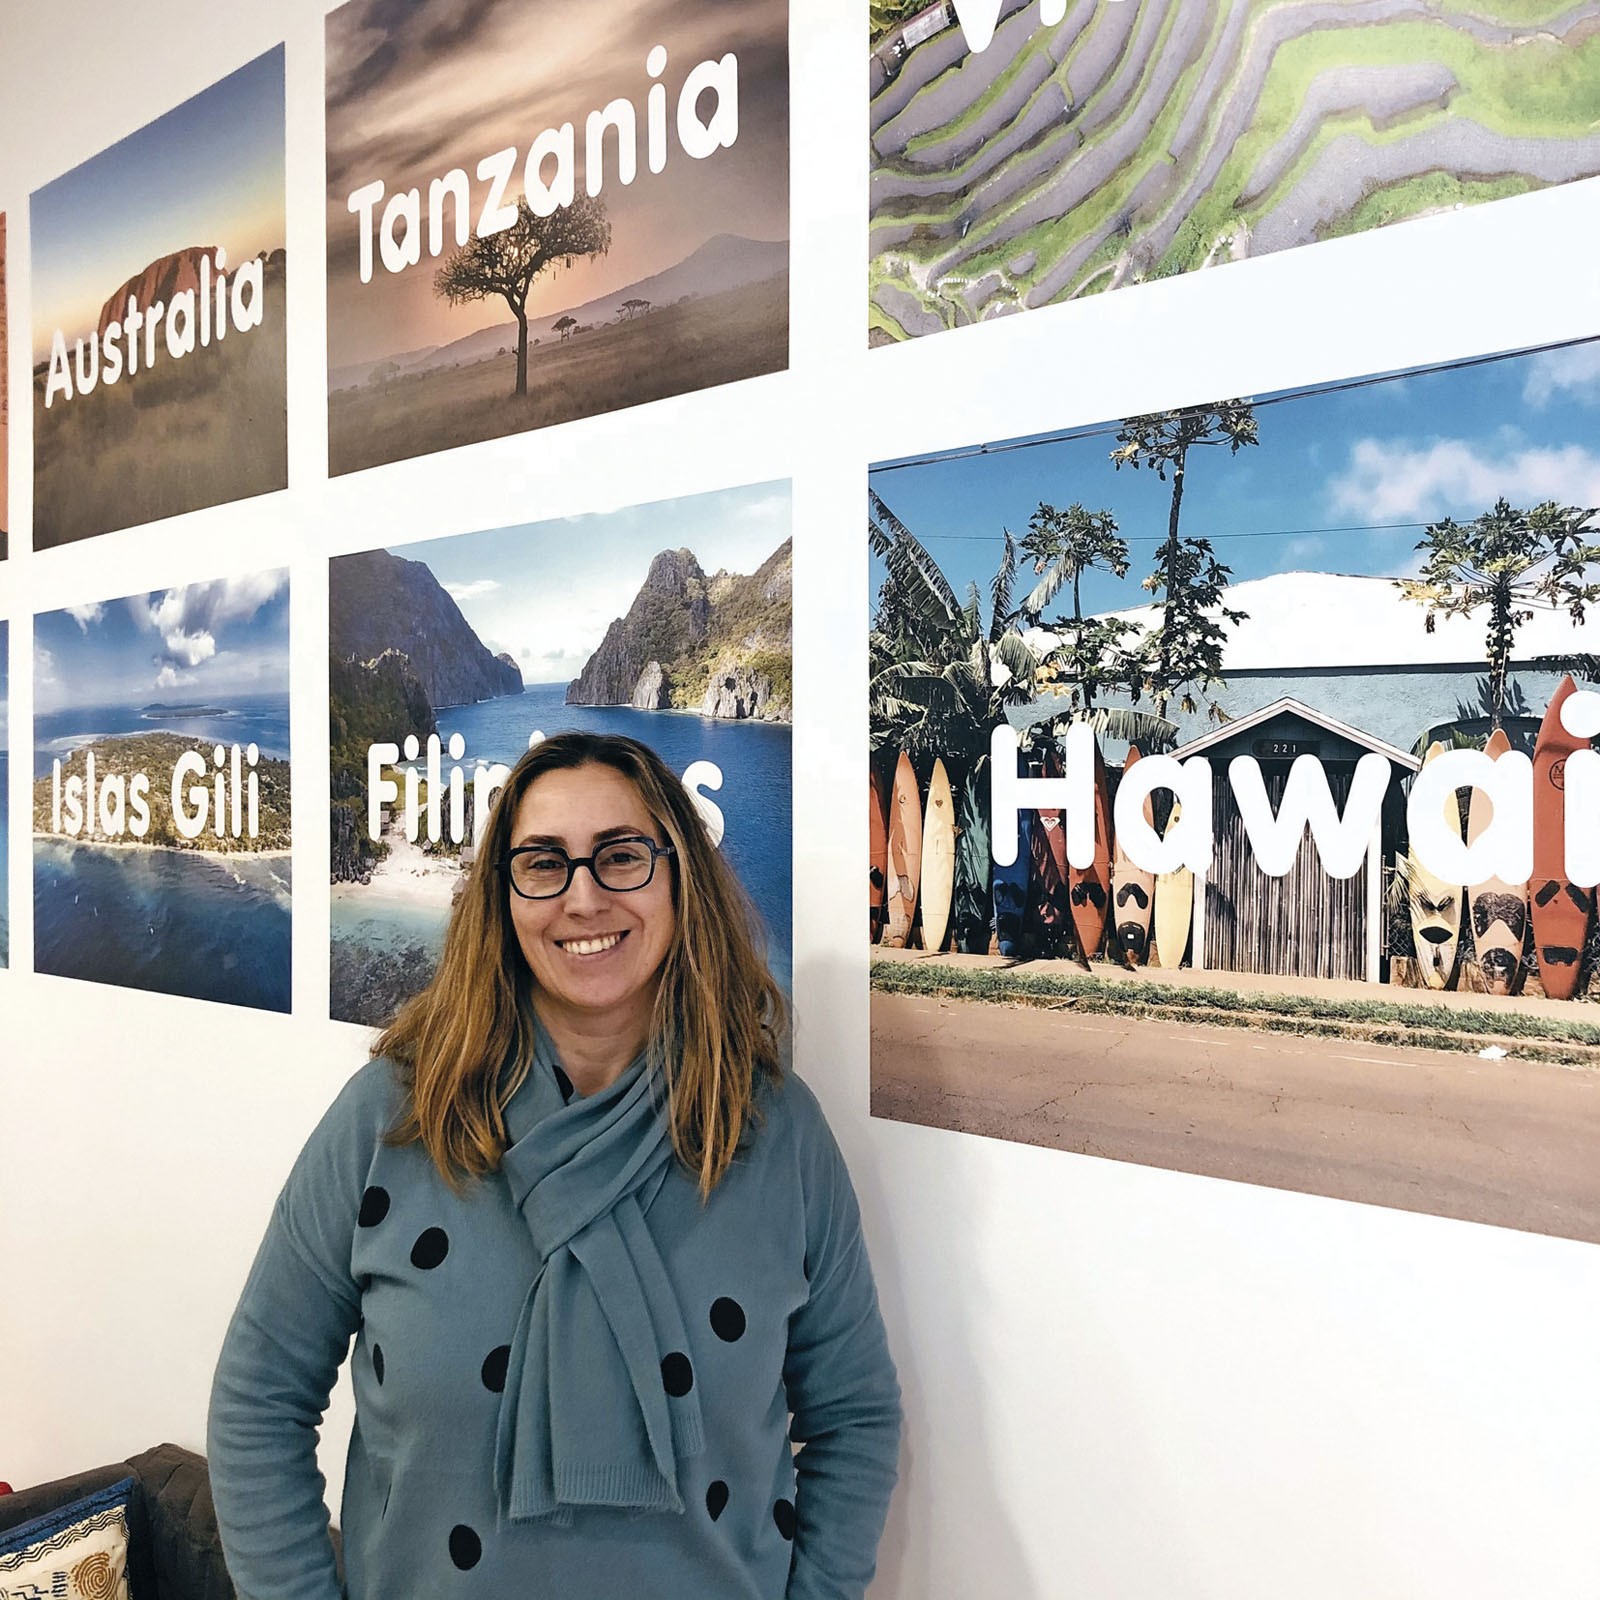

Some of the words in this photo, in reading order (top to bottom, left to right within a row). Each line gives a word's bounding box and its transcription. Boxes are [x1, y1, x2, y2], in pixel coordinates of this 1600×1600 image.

[347, 45, 739, 284] Tanzania
[45, 246, 264, 409] Australia
[52, 751, 150, 837] Islas
[171, 742, 260, 839] Gili
[367, 730, 725, 862] Filips
[1273, 744, 1297, 753] 221
